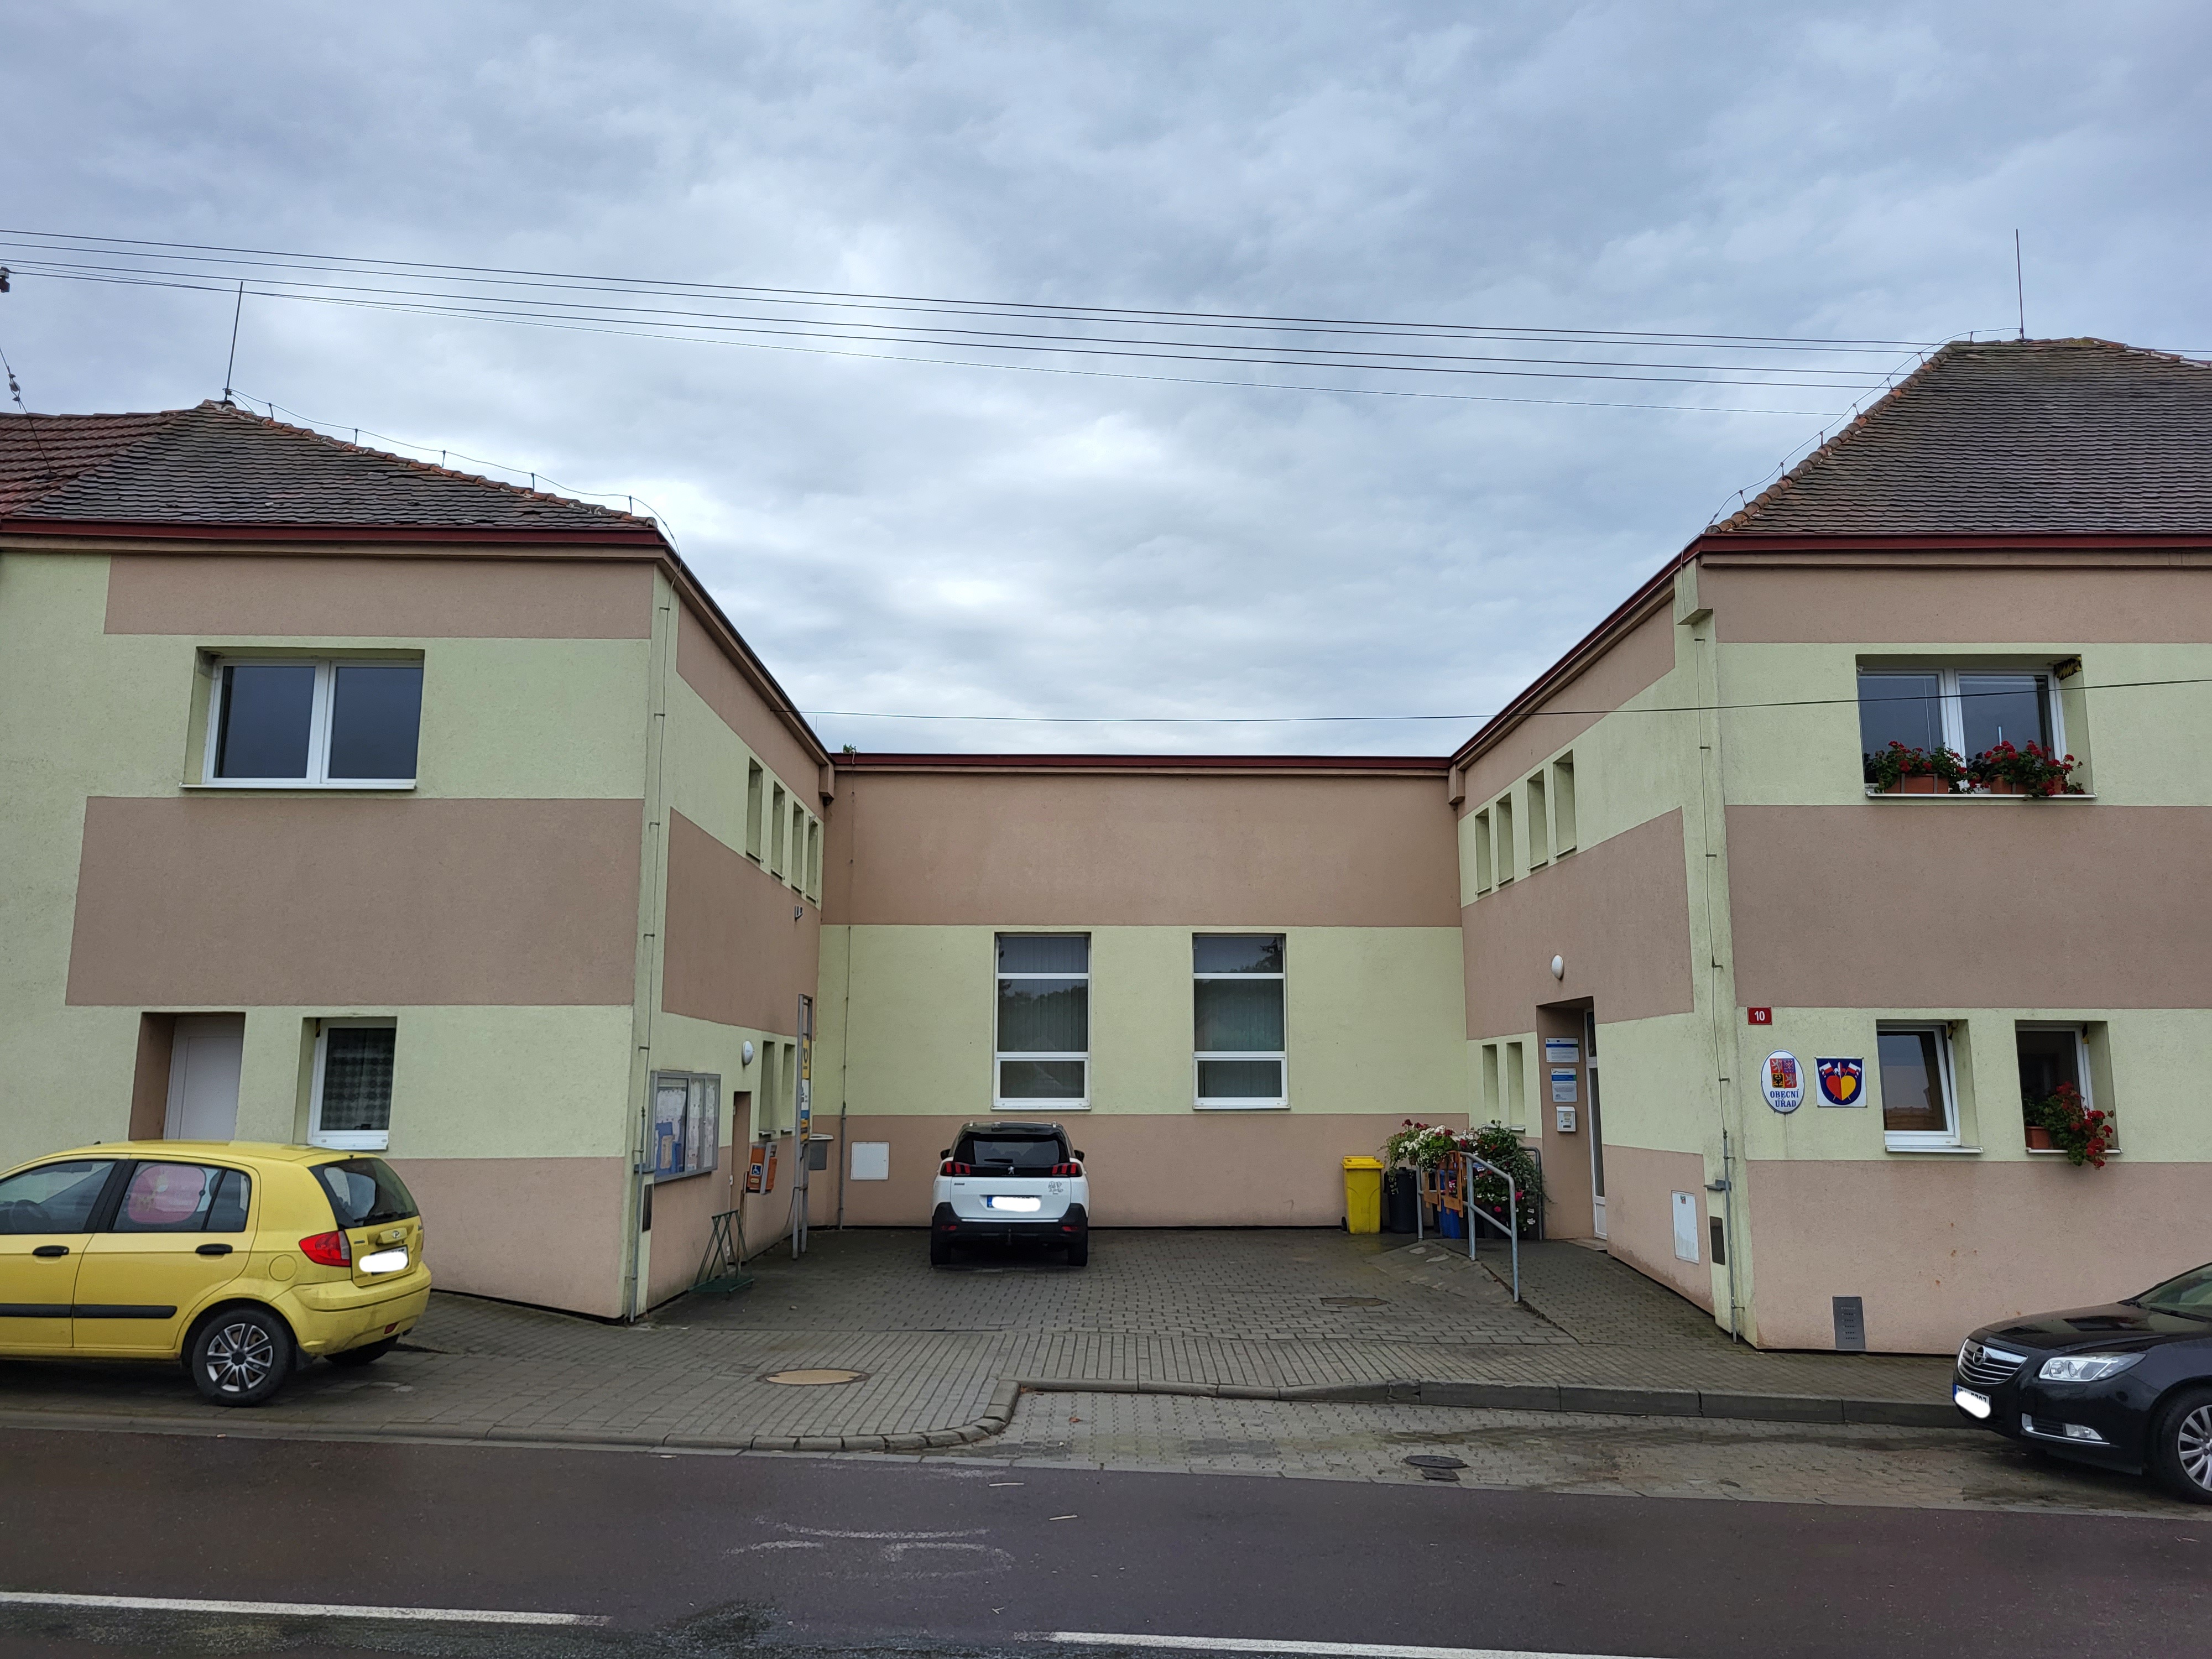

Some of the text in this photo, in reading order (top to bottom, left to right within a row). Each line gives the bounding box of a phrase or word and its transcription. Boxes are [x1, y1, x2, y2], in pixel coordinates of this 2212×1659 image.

[1754, 1010, 1765, 1021] 10
[1770, 1088, 1799, 1098] OBECNÍ
[1775, 1098, 1796, 1107] ÚŘAD
